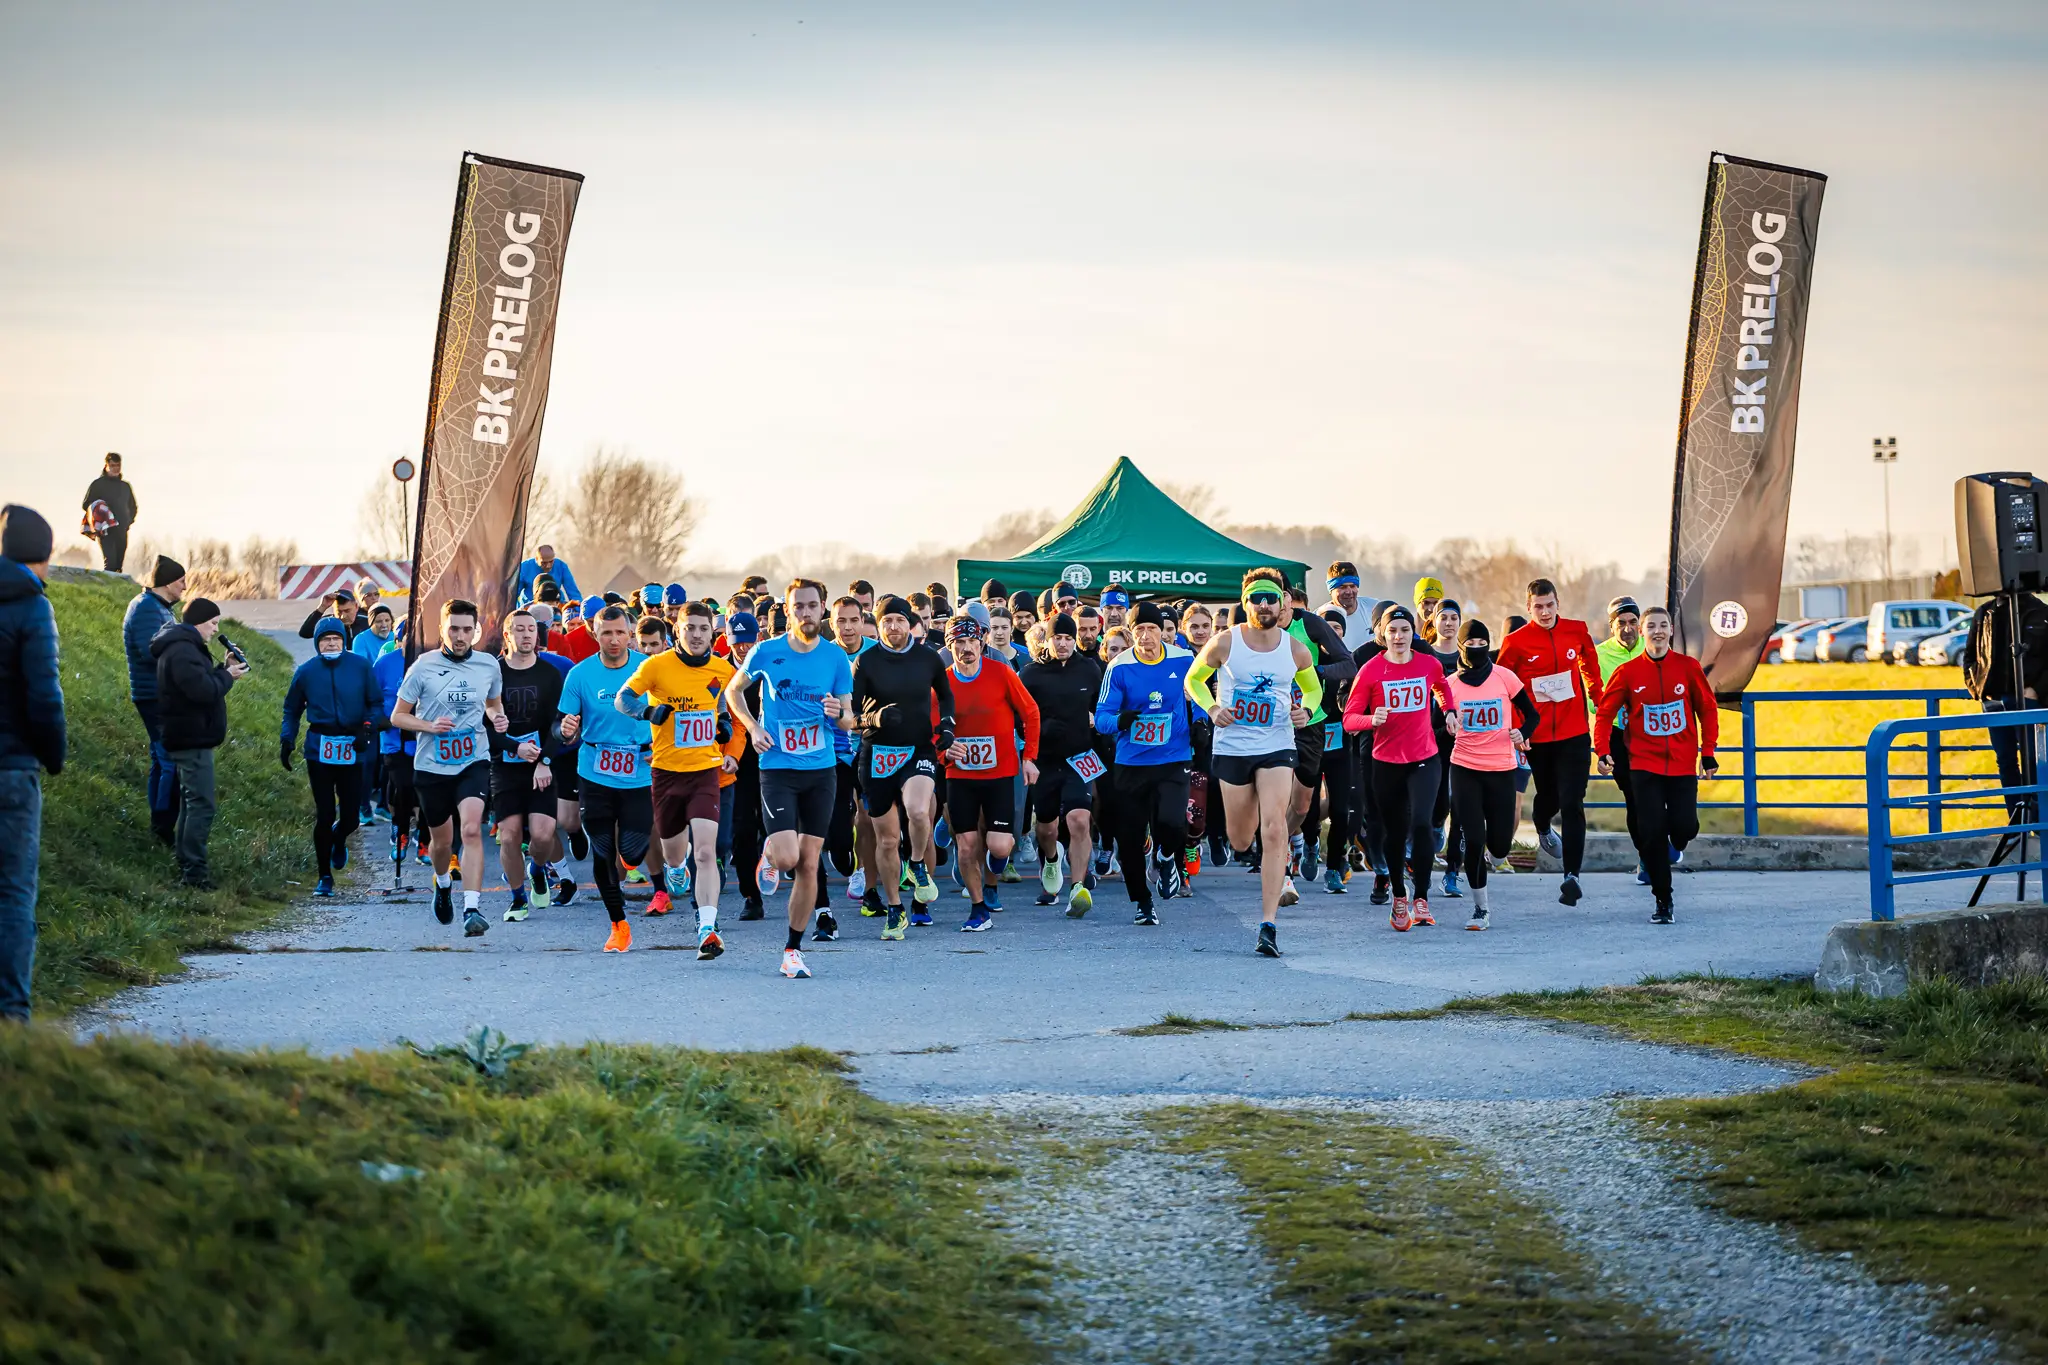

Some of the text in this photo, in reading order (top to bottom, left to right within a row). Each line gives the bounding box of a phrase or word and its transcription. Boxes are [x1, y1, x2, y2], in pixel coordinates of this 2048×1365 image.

[472, 211, 541, 445] BK PRELOG
[1730, 211, 1787, 433] BK PRELOG
[1109, 570, 1207, 584] BK PRELOG
[448, 693, 468, 702] K15
[668, 696, 693, 704] SWIM
[1389, 686, 1424, 709] 679
[1234, 699, 1271, 724] 690
[1463, 707, 1499, 727] 740
[1648, 709, 1682, 732] 593
[680, 718, 713, 742] 700
[785, 725, 819, 751] 847
[1134, 722, 1166, 742] 281
[323, 742, 353, 760] 818
[440, 736, 473, 760] 509
[600, 750, 635, 774] 888
[875, 753, 908, 774] 397
